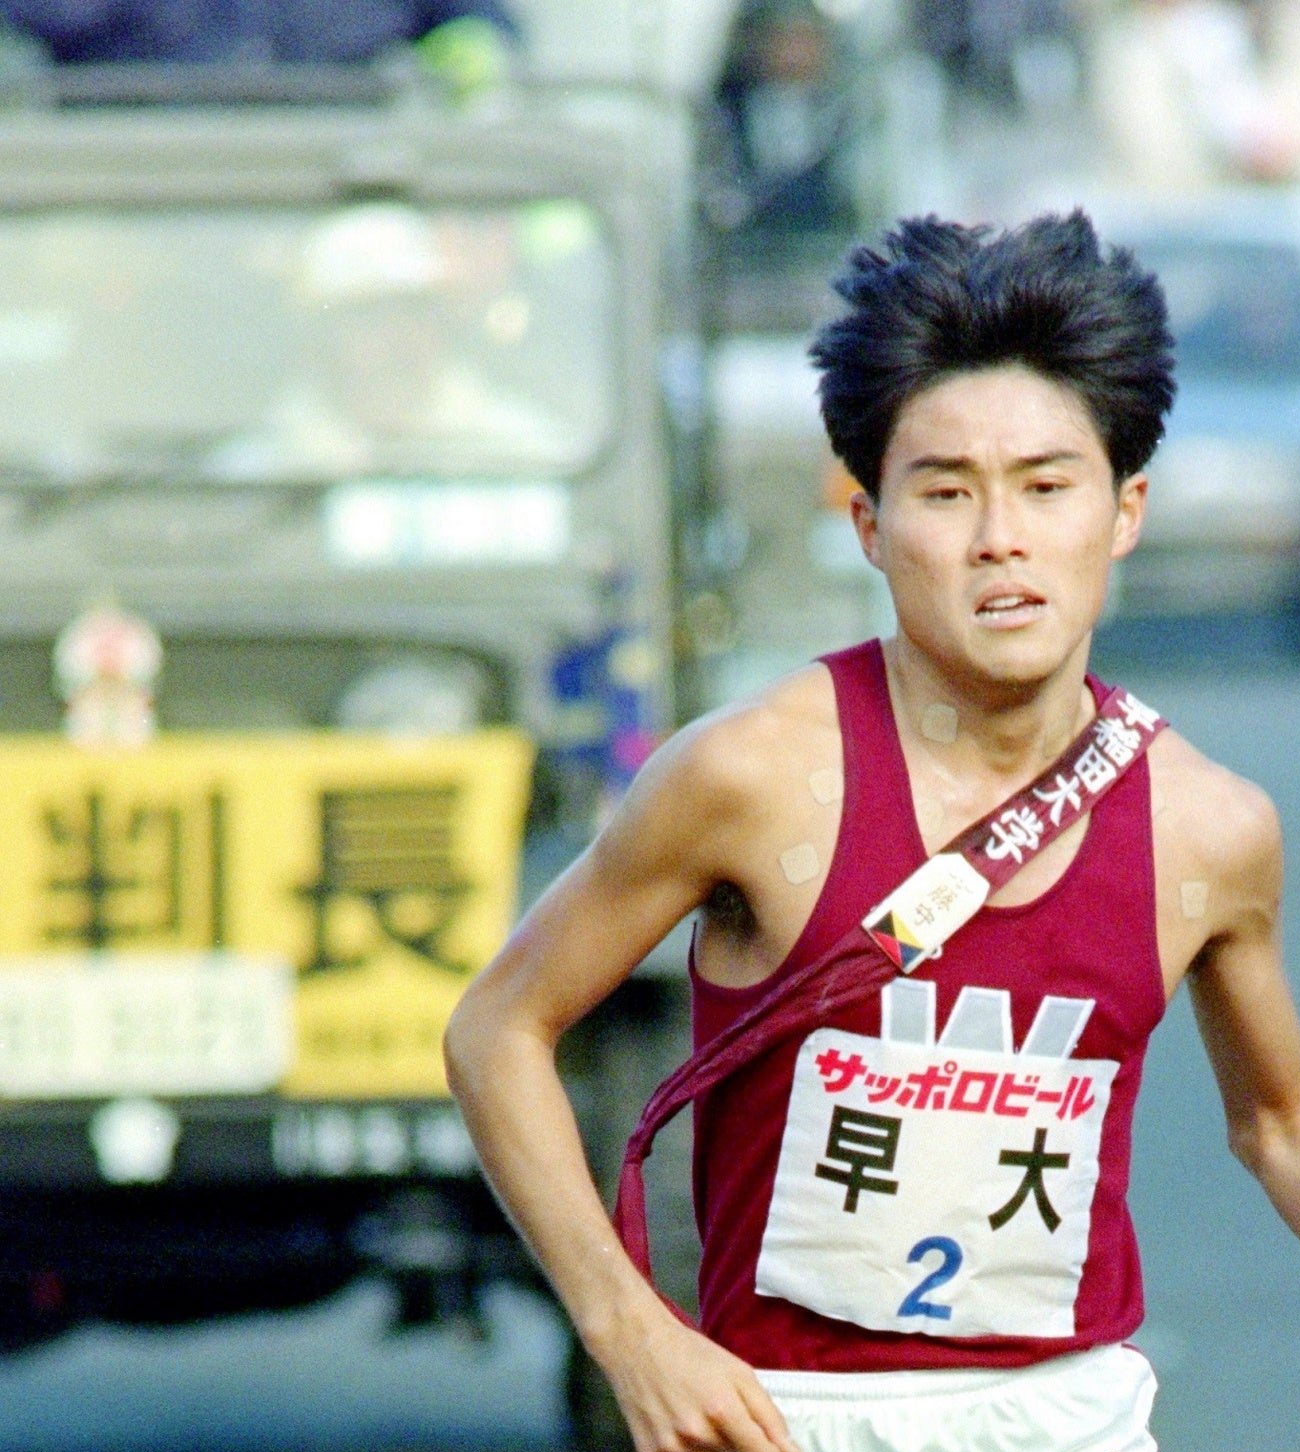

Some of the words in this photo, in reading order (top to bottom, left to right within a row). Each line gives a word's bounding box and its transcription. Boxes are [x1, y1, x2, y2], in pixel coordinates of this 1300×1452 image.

[815, 1048, 1096, 1122] サッポロビール
[897, 1236, 964, 1321] 2
